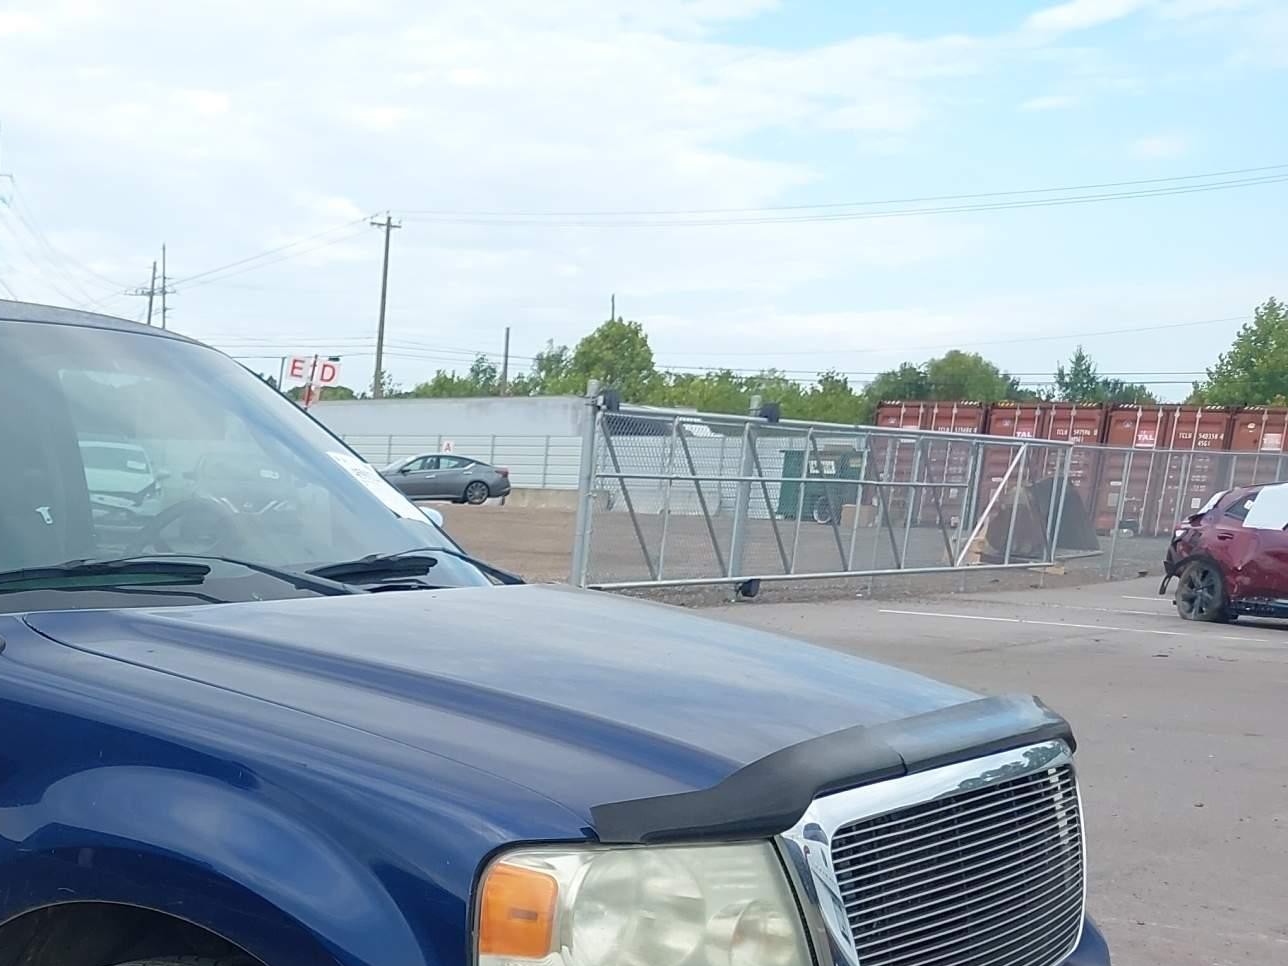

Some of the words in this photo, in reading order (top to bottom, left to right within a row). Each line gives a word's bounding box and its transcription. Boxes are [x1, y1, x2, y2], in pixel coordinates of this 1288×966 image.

[290, 359, 304, 378] E
[320, 364, 336, 382] D
[444, 442, 452, 452] A
